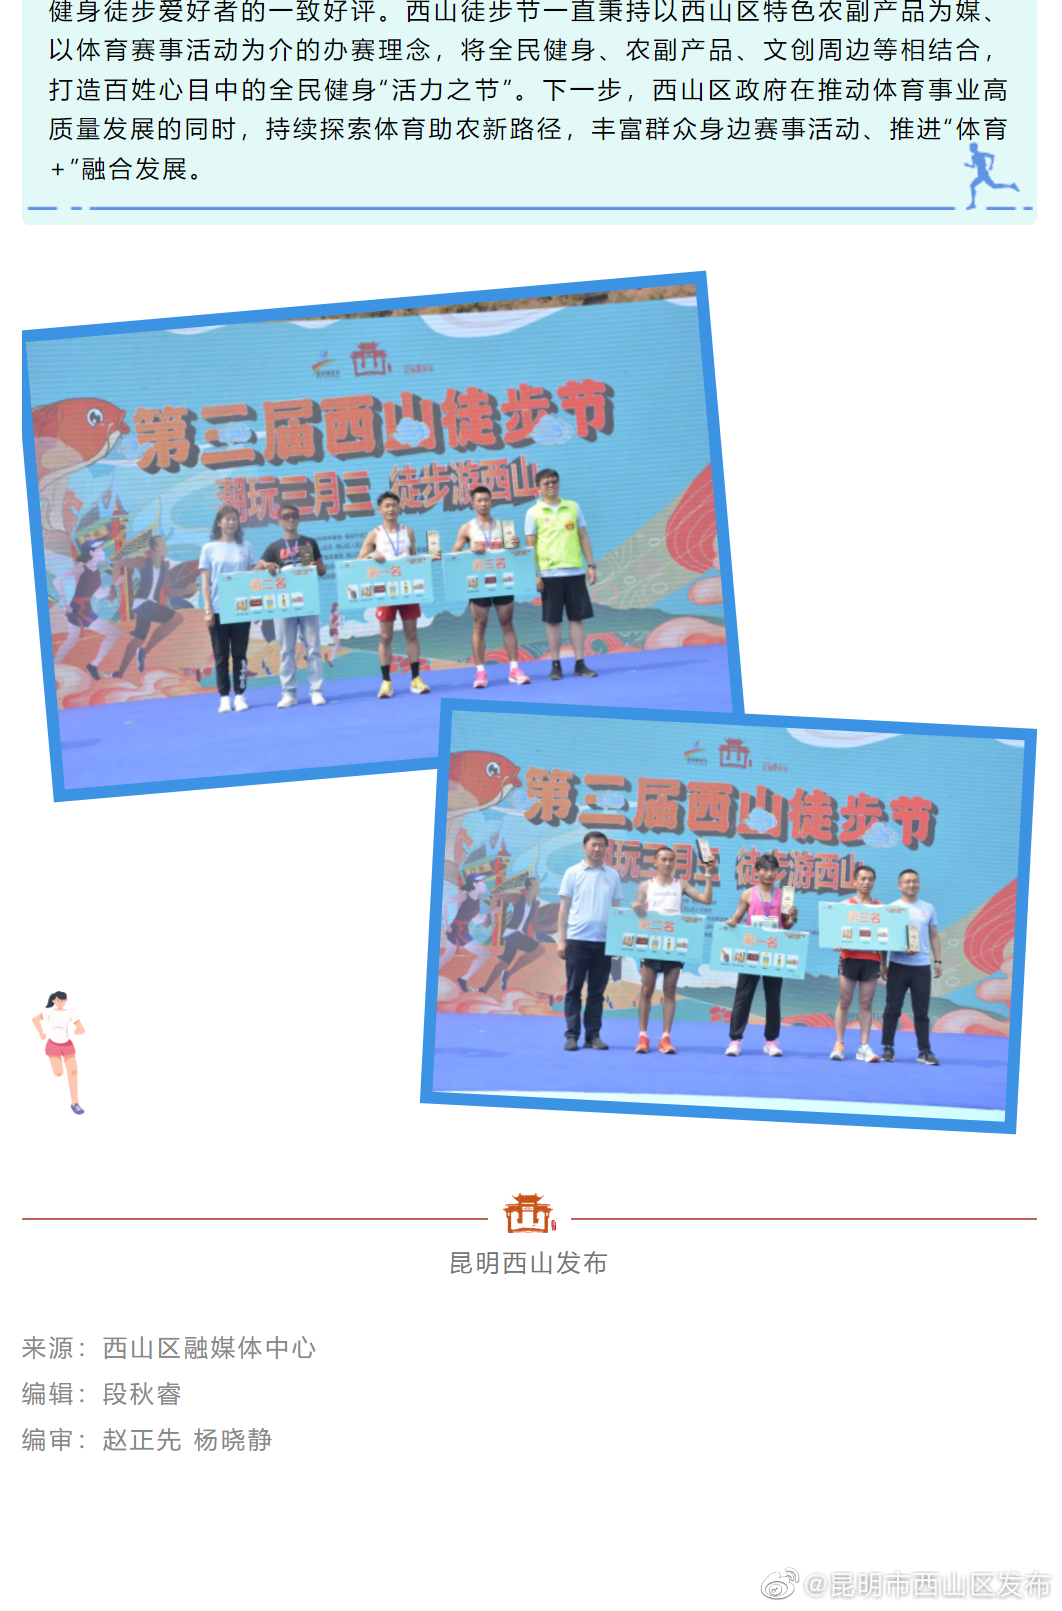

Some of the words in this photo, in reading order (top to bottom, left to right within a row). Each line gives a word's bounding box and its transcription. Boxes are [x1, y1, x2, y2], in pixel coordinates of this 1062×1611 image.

[132, 378, 614, 474] 第三届西山徒步节
[214, 470, 376, 526] 潮玩三月三
[388, 454, 541, 511] 徒步游西山
[366, 564, 402, 579] 第一名
[472, 557, 508, 571] 第三名
[249, 576, 287, 592] 第二名
[522, 765, 939, 851] 第三届西山徒步节
[847, 909, 882, 924] 第三名
[637, 917, 675, 933] 第二名
[742, 933, 779, 948] 第一名
